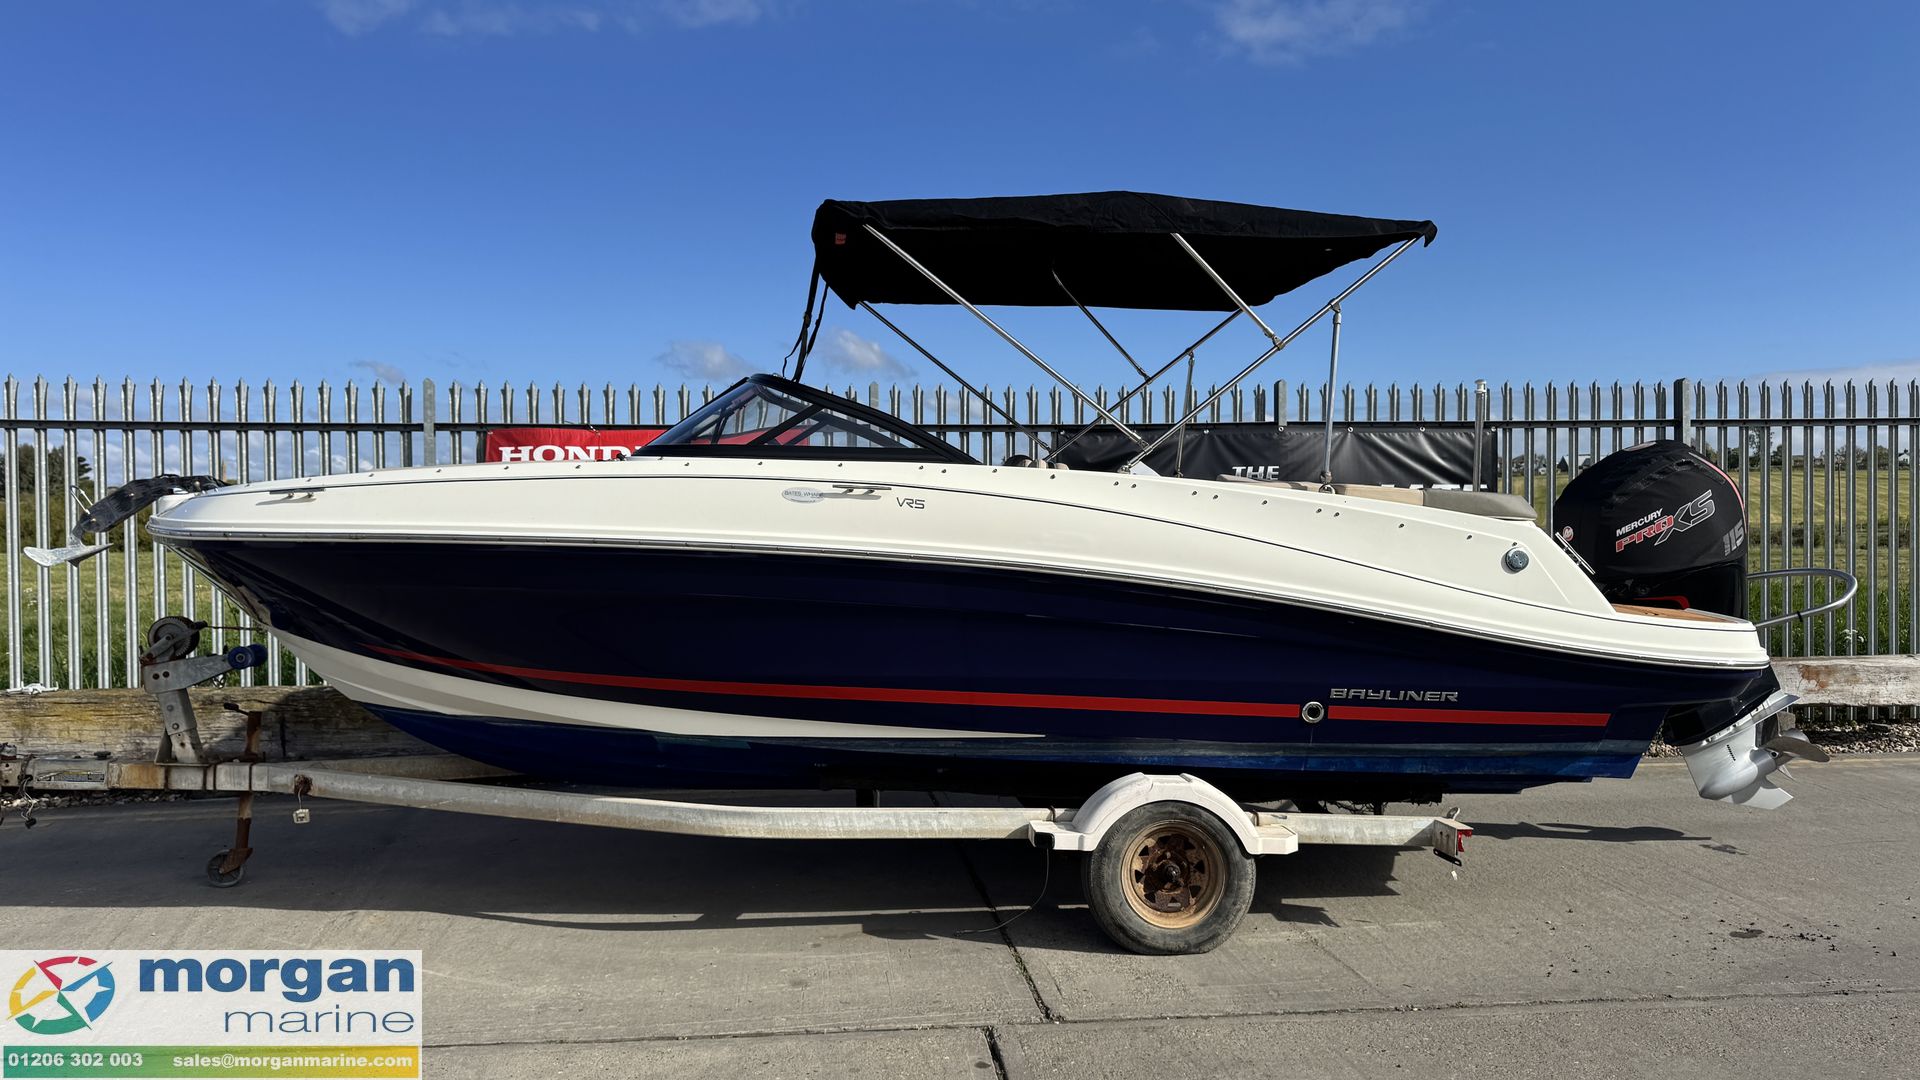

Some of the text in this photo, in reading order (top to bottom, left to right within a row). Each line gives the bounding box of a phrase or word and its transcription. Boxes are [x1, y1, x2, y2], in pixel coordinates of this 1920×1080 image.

[498, 444, 642, 462] HOND
[1232, 465, 1279, 480] THE
[1616, 508, 1663, 537] MERCURY
[1722, 519, 1745, 556] 115
[1329, 688, 1459, 702] BAYLINER
